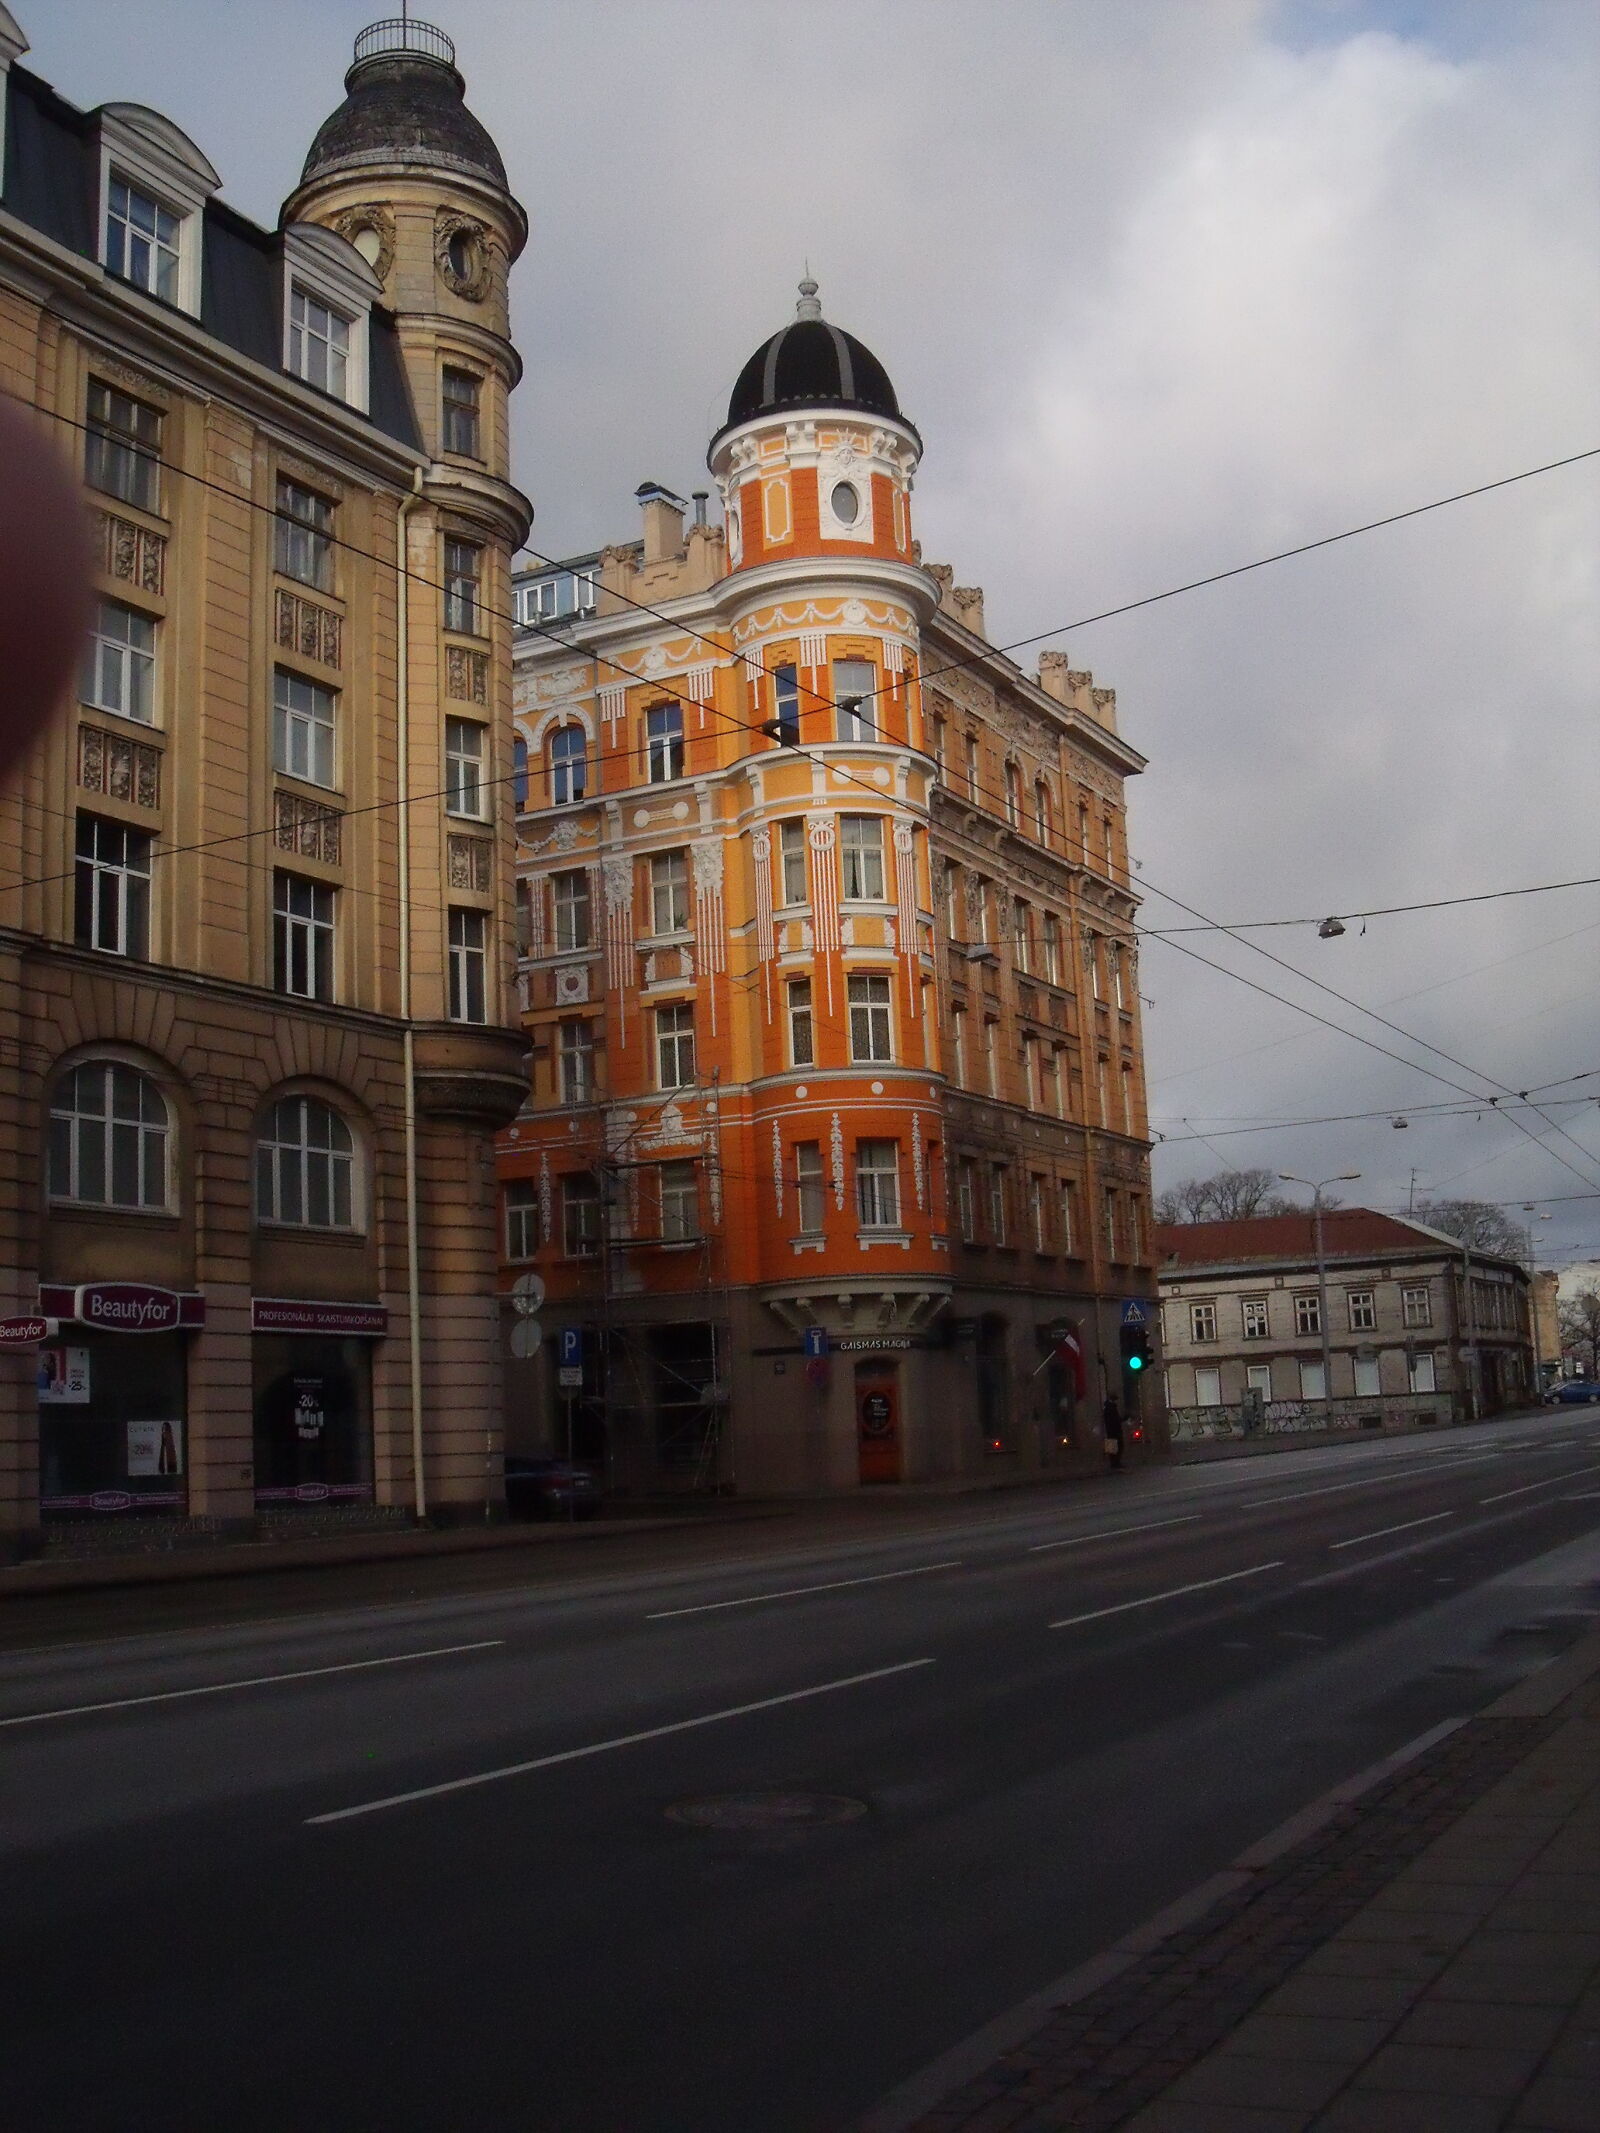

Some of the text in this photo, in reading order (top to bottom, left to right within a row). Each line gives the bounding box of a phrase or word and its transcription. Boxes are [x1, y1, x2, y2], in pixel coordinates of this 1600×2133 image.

[91, 1295, 170, 1326] Beautyfor
[0, 1322, 42, 1340] Beautyfor
[565, 1331, 577, 1360] P
[840, 1340, 881, 1351] GAISMAS
